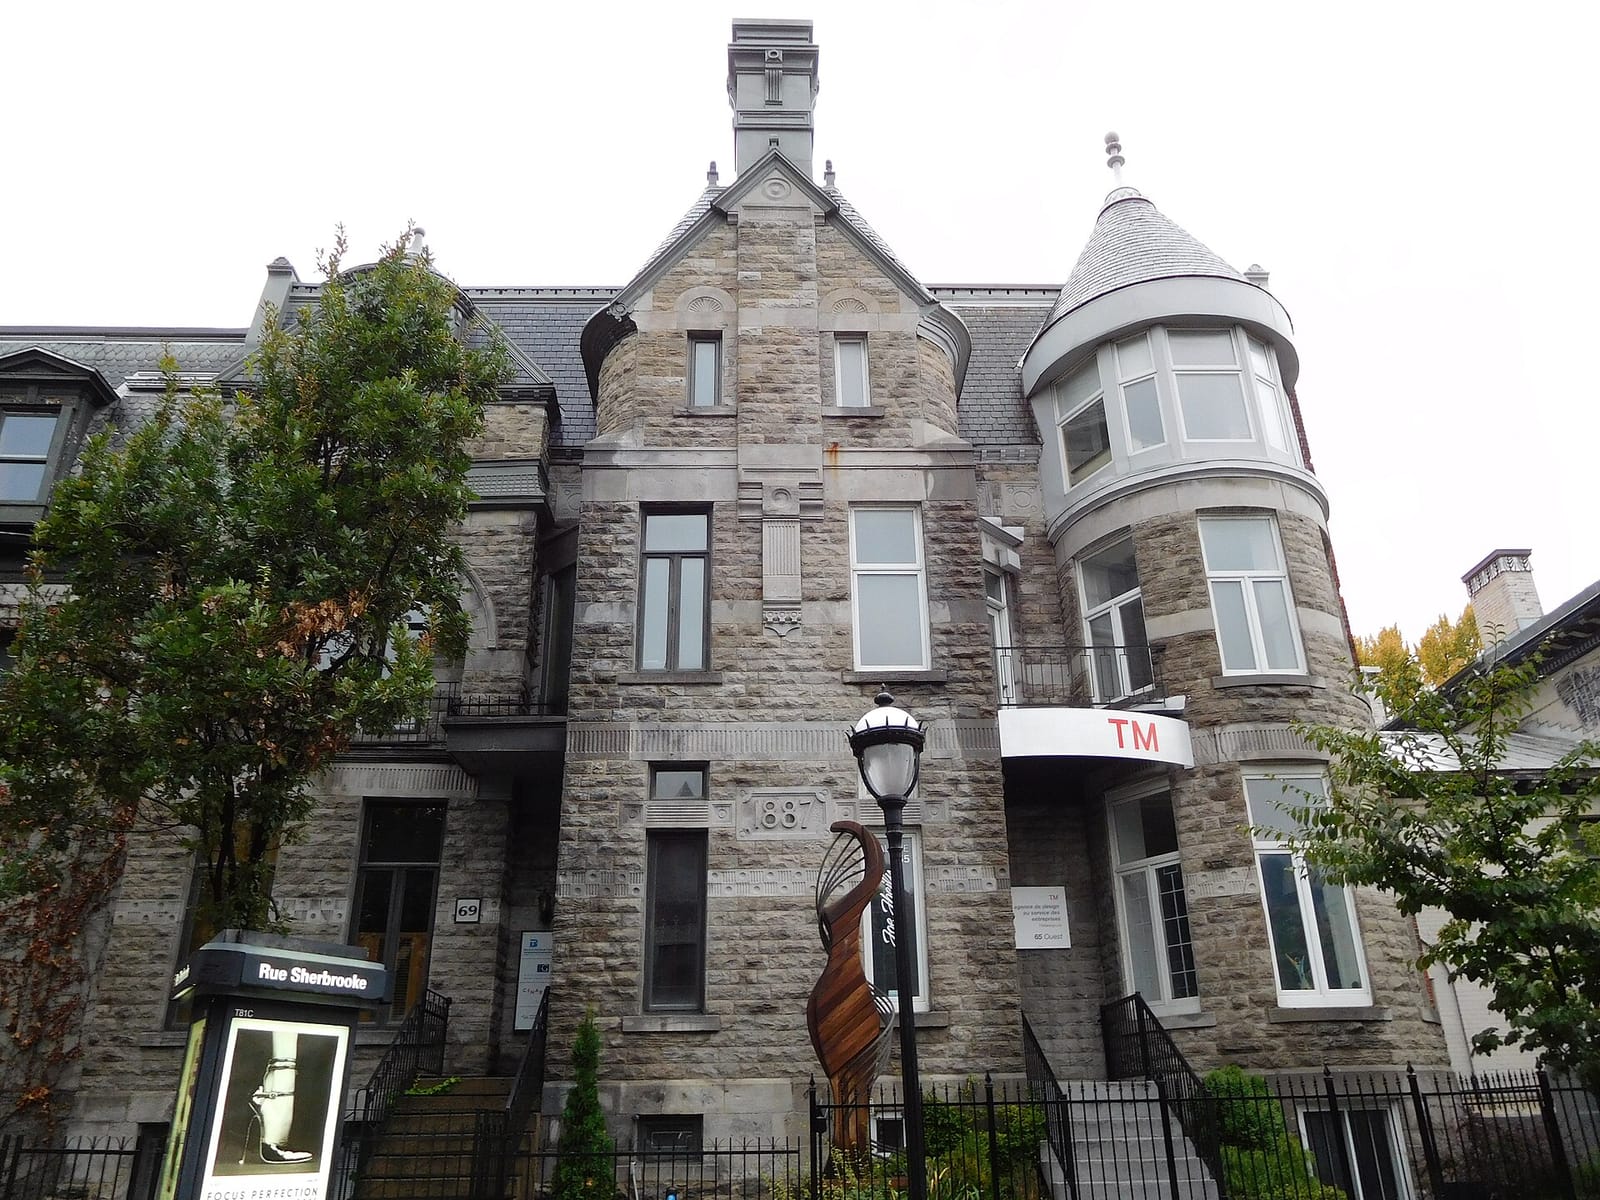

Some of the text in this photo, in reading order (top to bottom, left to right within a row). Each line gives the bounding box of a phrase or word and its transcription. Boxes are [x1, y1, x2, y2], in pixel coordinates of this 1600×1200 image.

[1107, 718, 1159, 752] TM
[754, 801, 812, 829] 1887
[458, 905, 478, 917] 69
[258, 963, 368, 990] Rue Sherbrooke
[207, 1187, 318, 1200] FOCUS PERFECTION
